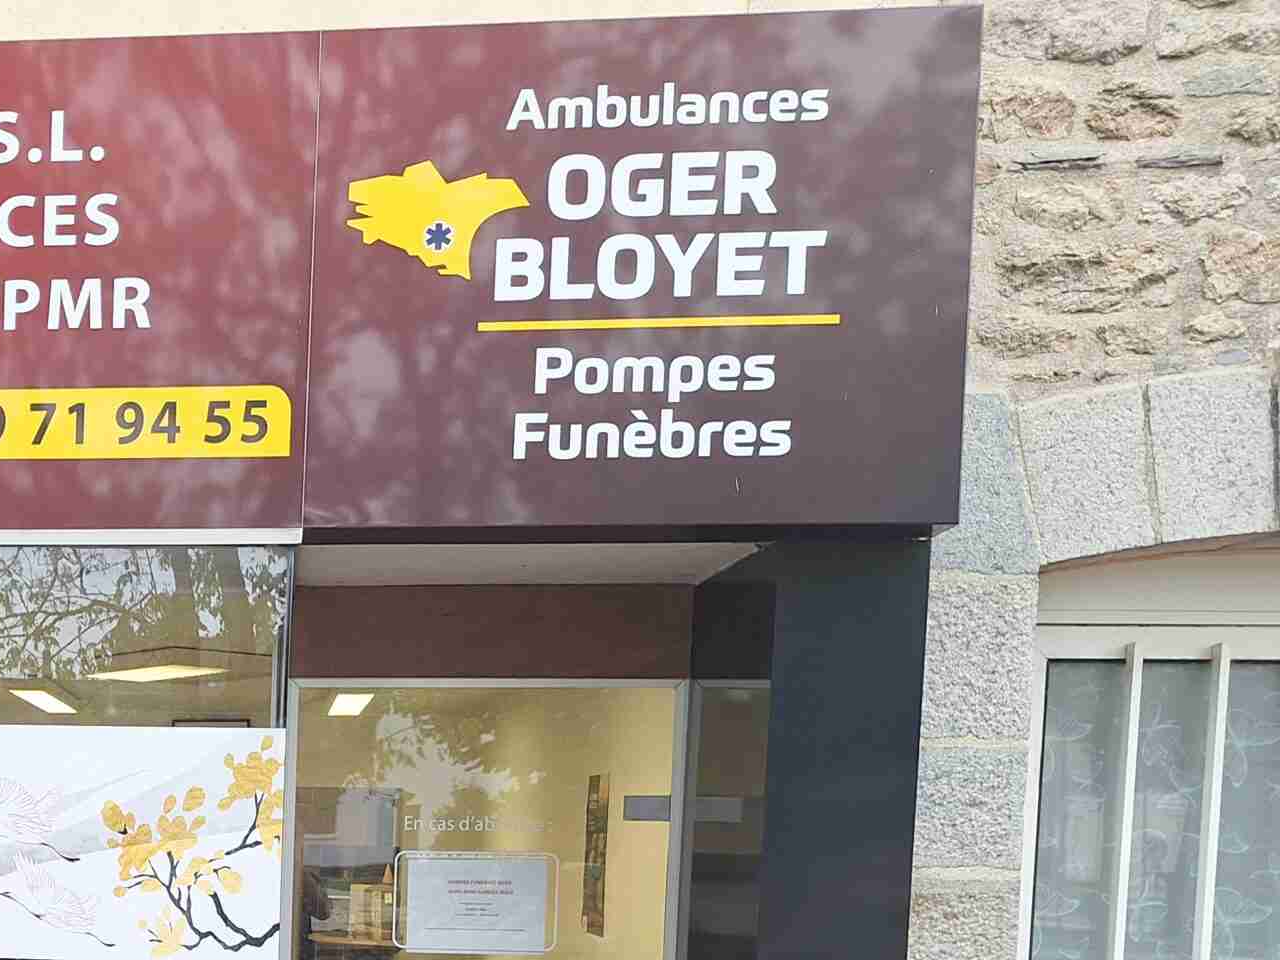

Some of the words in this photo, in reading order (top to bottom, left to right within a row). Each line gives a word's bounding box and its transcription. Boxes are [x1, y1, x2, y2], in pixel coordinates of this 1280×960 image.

[506, 81, 830, 131] Ambulances
[547, 150, 777, 220] OGER
[494, 230, 827, 302] BLOYET
[534, 347, 775, 402] Pompes
[29, 402, 86, 444] 71
[115, 401, 180, 443] 94
[204, 399, 269, 442] 55
[512, 409, 792, 460] Funèbres
[429, 818, 456, 832] cas
